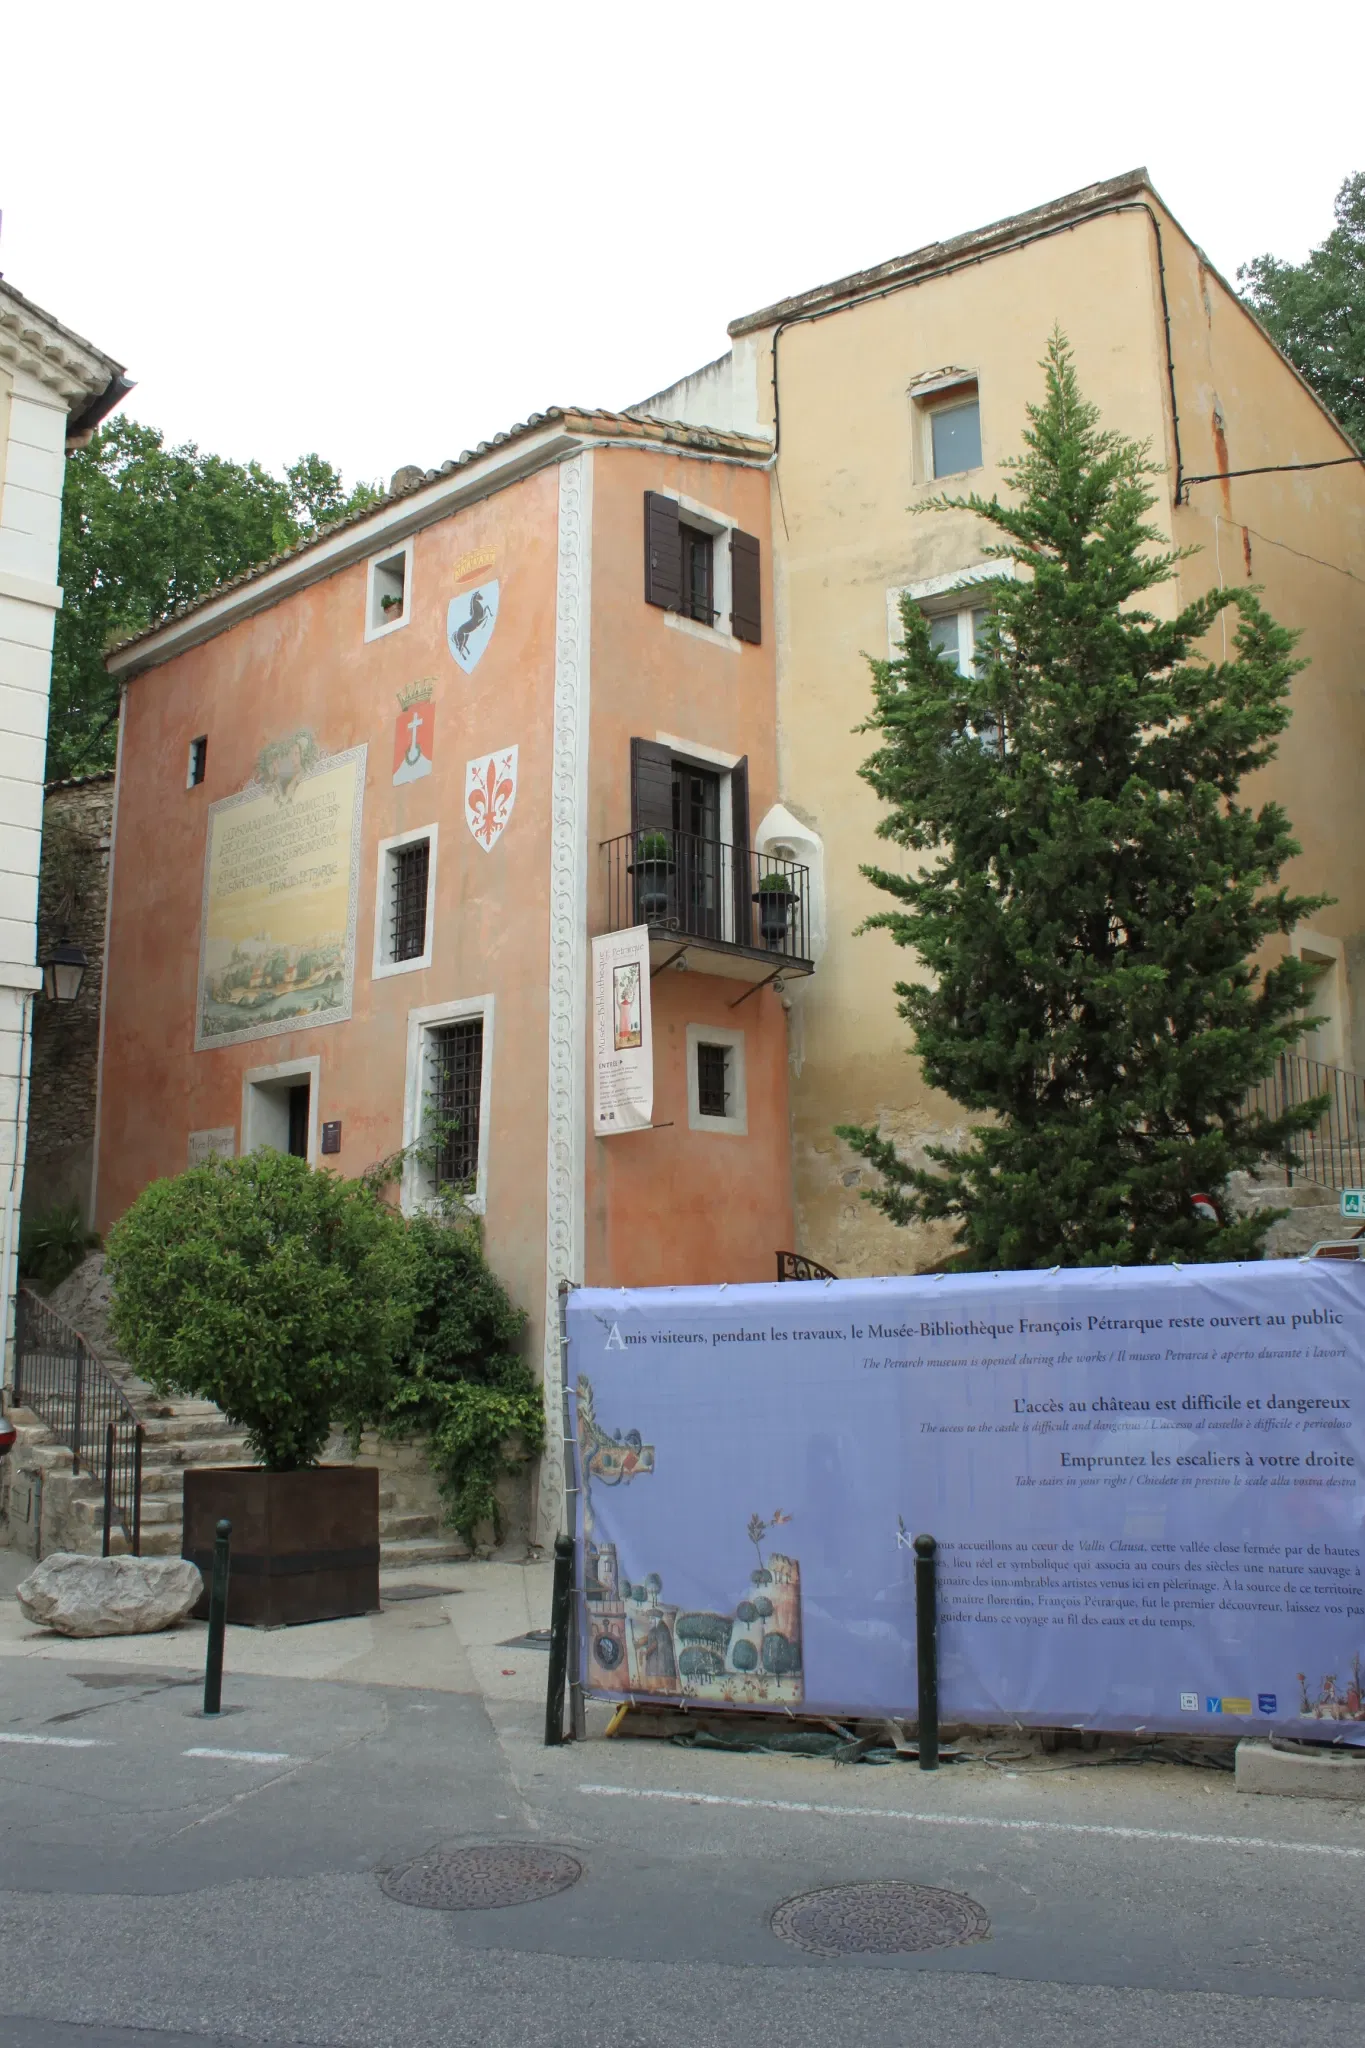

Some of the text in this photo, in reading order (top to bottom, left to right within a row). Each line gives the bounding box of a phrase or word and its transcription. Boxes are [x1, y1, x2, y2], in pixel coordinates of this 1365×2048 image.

[604, 1308, 1344, 1350] Amis visiteurs, pendant les travaux, le Musée-Bibliothèque François Pétrarque reste ouvert au public
[862, 1358, 880, 1369] The
[883, 1356, 923, 1368] Petrarch
[927, 1358, 967, 1367] museum
[970, 1356, 979, 1366] is
[981, 1354, 1017, 1369] opened
[1019, 1354, 1054, 1367] during
[1057, 1353, 1073, 1364] the
[1076, 1352, 1107, 1362] works
[1117, 1349, 1126, 1361] Il
[1128, 1352, 1161, 1361] museo
[1164, 1349, 1209, 1361] Petrarca
[1221, 1350, 1254, 1363] aperto
[1258, 1347, 1302, 1359] durante
[1313, 1346, 1347, 1358] lavori
[1069, 1401, 1087, 1412] au
[1091, 1396, 1150, 1412] château
[1155, 1398, 1177, 1411] est
[1181, 1394, 1242, 1410] difficile
[1246, 1397, 1261, 1410] et
[1266, 1393, 1351, 1414] dangereux
[919, 1422, 937, 1433] The
[939, 1424, 964, 1433] access
[967, 1423, 975, 1433] to
[978, 1421, 993, 1432] the
[995, 1421, 1019, 1432] castle
[1022, 1422, 1029, 1432] is
[1032, 1421, 1069, 1435] difficult
[1071, 1420, 1091, 1431] and
[1093, 1419, 1141, 1433] dangerous
[1195, 1419, 1206, 1429] al
[1208, 1418, 1243, 1429] castello
[1254, 1418, 1292, 1432] difficile
[1302, 1418, 1352, 1432] pericoloso
[1060, 1450, 1355, 1471] Empruntez les escaliers à votre droite
[1015, 1475, 1034, 1487] Take
[1038, 1476, 1064, 1486] stairs
[1066, 1476, 1076, 1486] in
[1078, 1477, 1100, 1488] your
[1103, 1475, 1126, 1488] right
[1136, 1474, 1179, 1486] Chiedete
[1182, 1476, 1192, 1486] in
[1194, 1475, 1230, 1488] prestito
[1233, 1475, 1241, 1486] le
[1244, 1475, 1268, 1486] scale
[1270, 1475, 1289, 1486] alla
[1293, 1477, 1323, 1487] vostra
[1326, 1476, 1356, 1488] destra
[936, 1541, 955, 1550] ous
[957, 1540, 1013, 1551] accueillons
[1015, 1543, 1028, 1551] au
[1061, 1540, 1074, 1551] de
[1079, 1540, 1105, 1551] Vallis
[1151, 1542, 1176, 1552] cette
[1180, 1541, 1210, 1552] vallée
[1213, 1541, 1240, 1553] close
[1244, 1543, 1280, 1554] fermée
[1285, 1546, 1303, 1557] par
[1307, 1544, 1320, 1555] de
[1324, 1544, 1360, 1557] hautes
[953, 1557, 972, 1568] lieu
[976, 1558, 993, 1568] réel
[997, 1560, 1008, 1568] et
[1010, 1558, 1069, 1572] symbolique
[1073, 1560, 1091, 1572] qui
[1095, 1560, 1130, 1570] associa
[1135, 1562, 1147, 1571] au
[1151, 1562, 1180, 1571] cours
[1184, 1560, 1202, 1572] des
[1206, 1561, 1239, 1572] siècles
[1244, 1564, 1265, 1573] une
[1268, 1565, 1304, 1574] nature
[1308, 1566, 1351, 1579] sauvage
[1355, 1565, 1361, 1576] à
[973, 1576, 988, 1587] des
[991, 1576, 1060, 1588] innombrables
[1062, 1578, 1097, 1588] artistes
[1100, 1580, 1130, 1589] venus
[1132, 1578, 1145, 1589] ici
[1147, 1581, 1160, 1590] en
[1234, 1580, 1243, 1591] la
[1247, 1583, 1281, 1593] source
[1283, 1581, 1297, 1593] de
[1299, 1585, 1311, 1594] ce
[1314, 1583, 1363, 1596] territoire
[940, 1594, 949, 1604] le
[1038, 1595, 1081, 1608] François
[1160, 1597, 1170, 1608] le
[1173, 1600, 1215, 1612] premier
[1287, 1601, 1320, 1613] laissez
[1324, 1605, 1343, 1614] vos
[1347, 1605, 1364, 1618] pas
[940, 1612, 972, 1624] guider
[975, 1612, 998, 1623] dans
[1001, 1615, 1012, 1624] ce
[1015, 1616, 1049, 1627] voyage
[1052, 1616, 1064, 1624] au
[1067, 1613, 1078, 1624] fil
[1081, 1614, 1099, 1625] des
[1102, 1616, 1125, 1625] eaux
[1128, 1616, 1139, 1626] et
[1142, 1616, 1156, 1627] du
